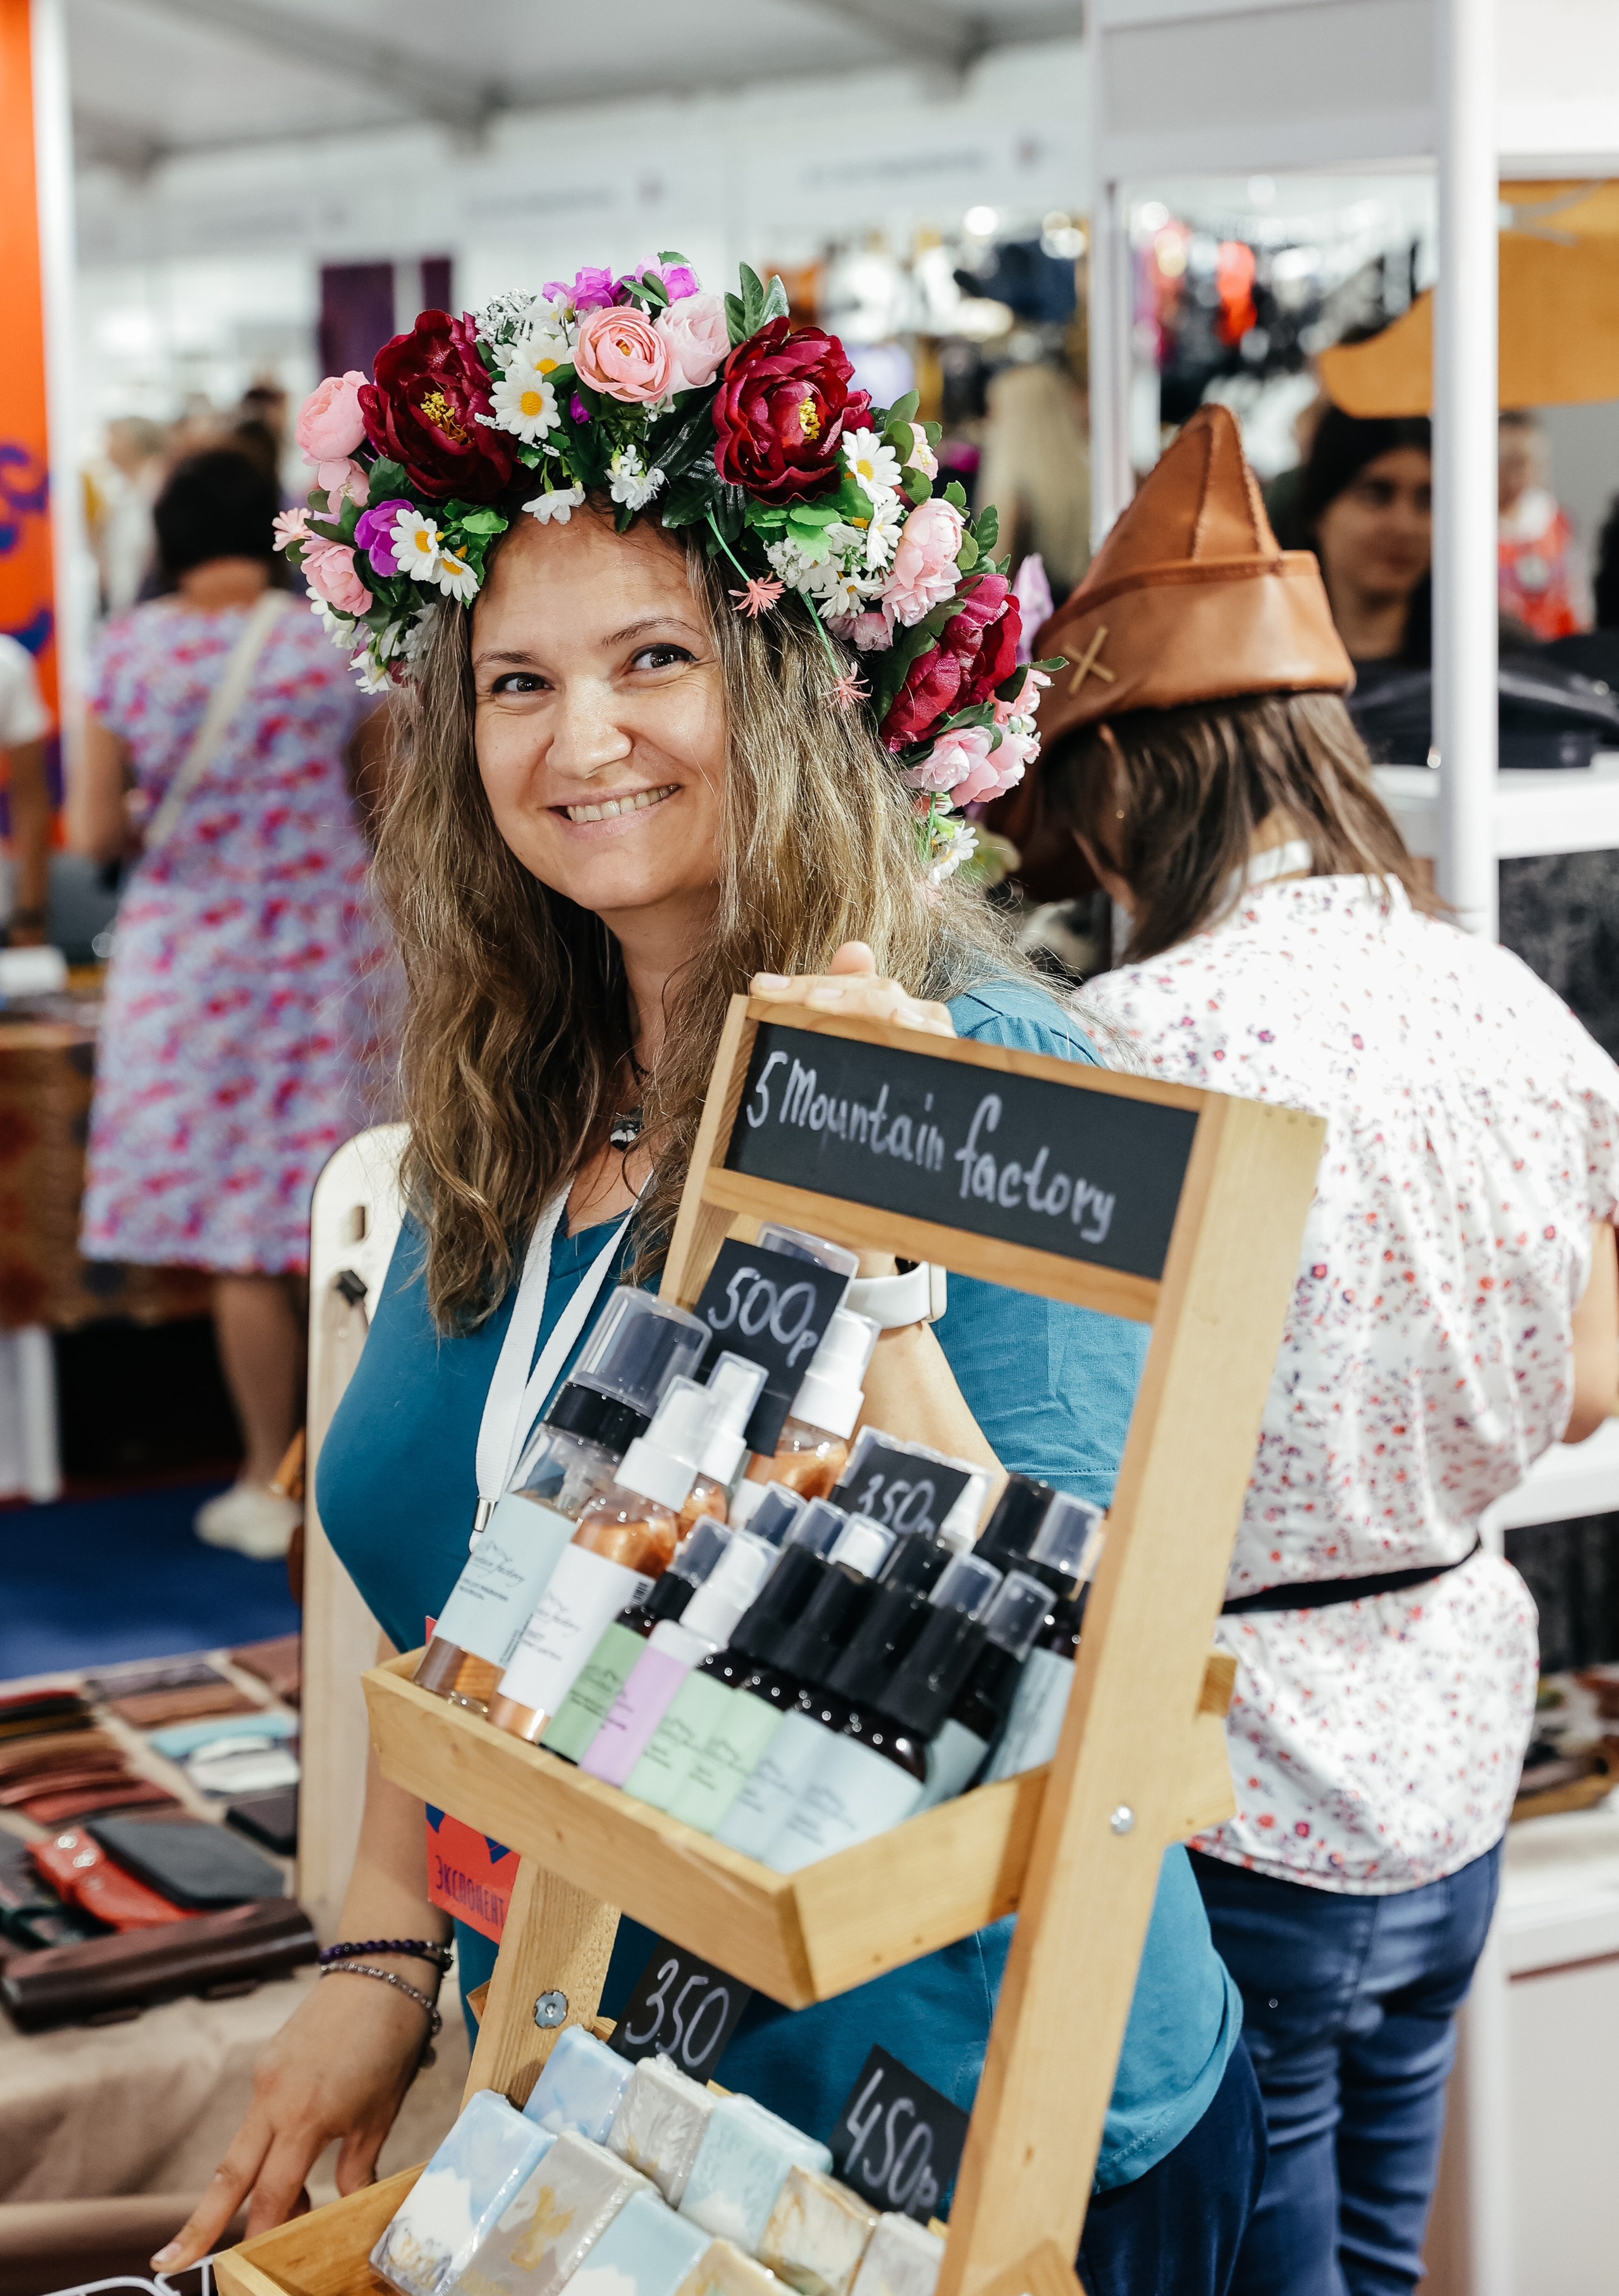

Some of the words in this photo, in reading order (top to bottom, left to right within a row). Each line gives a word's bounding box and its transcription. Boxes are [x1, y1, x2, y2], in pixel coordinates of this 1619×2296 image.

[746, 1050, 789, 1129] 5
[779, 1057, 945, 1172] Mountain
[954, 1093, 1117, 1244] factory
[435, 1855, 505, 1929] ЭКСПОНЕНТ
[625, 1958, 730, 2068] 350
